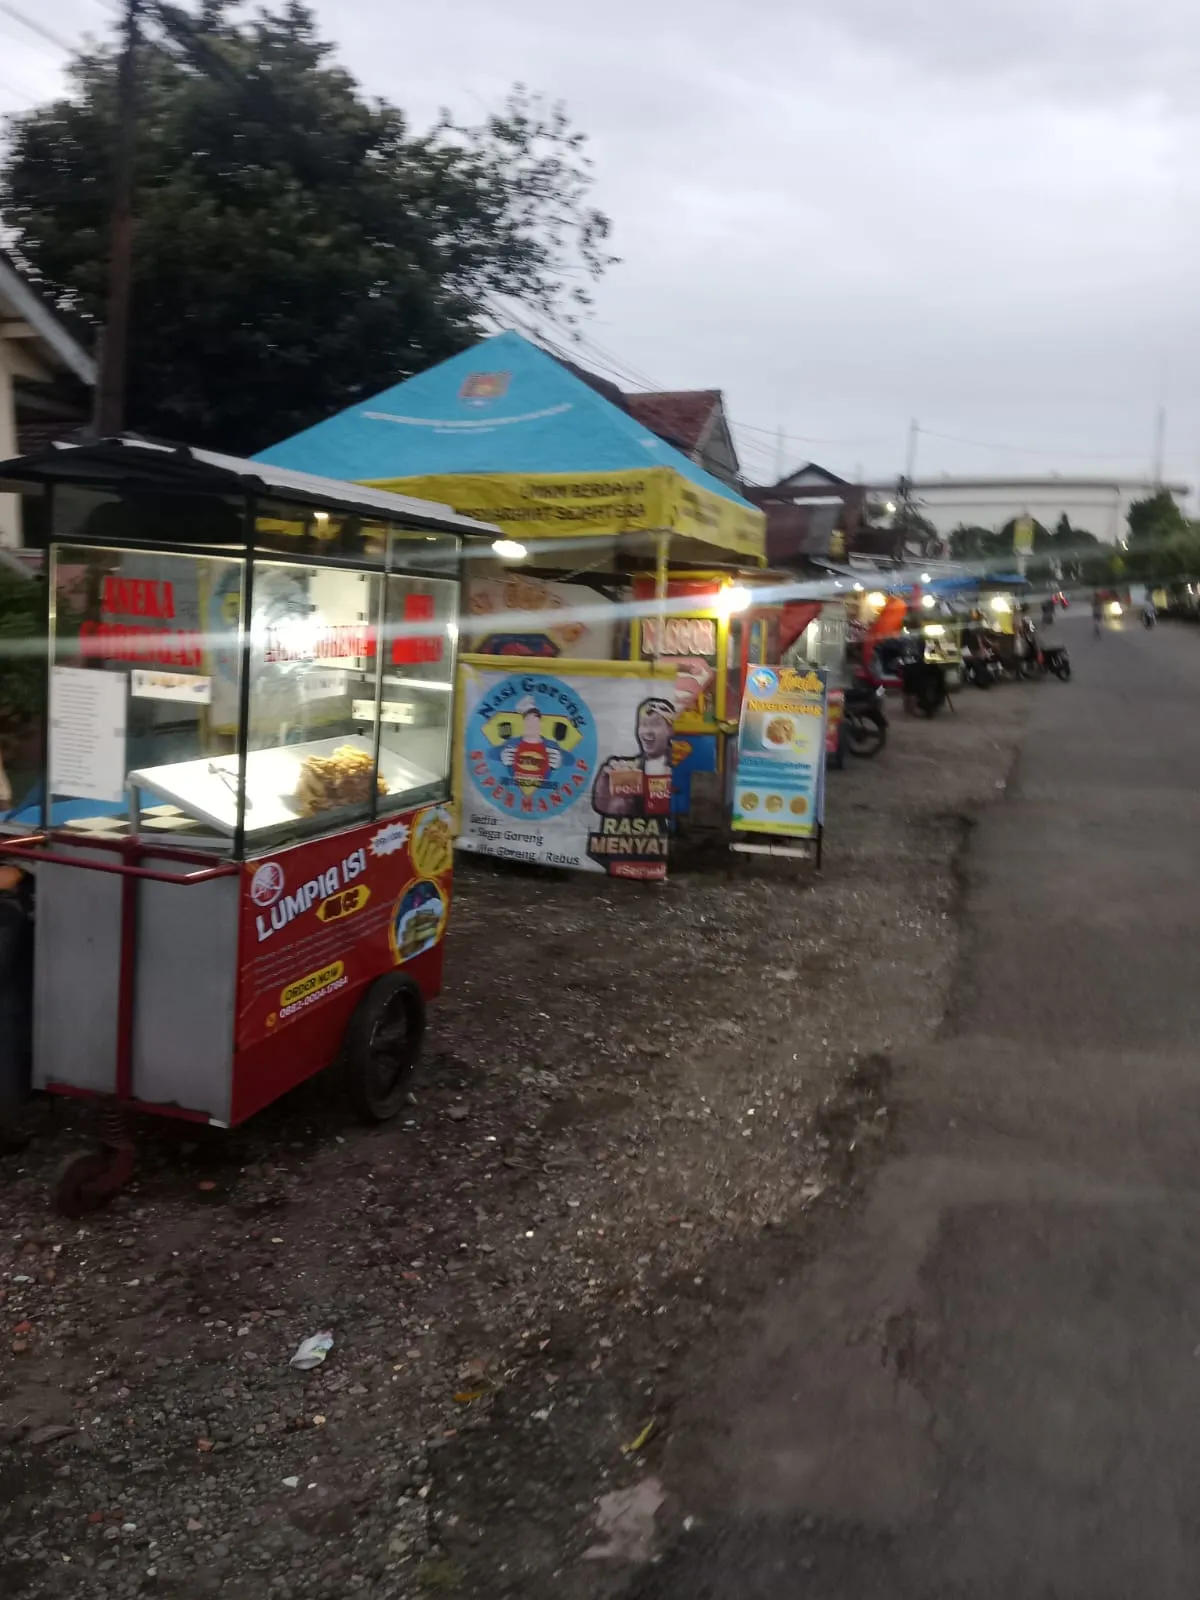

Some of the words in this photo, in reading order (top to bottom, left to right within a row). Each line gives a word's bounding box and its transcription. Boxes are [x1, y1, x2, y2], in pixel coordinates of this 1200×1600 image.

[102, 576, 176, 618] ANEKA
[520, 677, 587, 728] Goreng
[503, 830, 545, 847] Goreng
[603, 817, 660, 836] RASA
[546, 850, 581, 866] Rebus
[256, 866, 341, 942] LUMPIA
[341, 847, 367, 883] ISI
